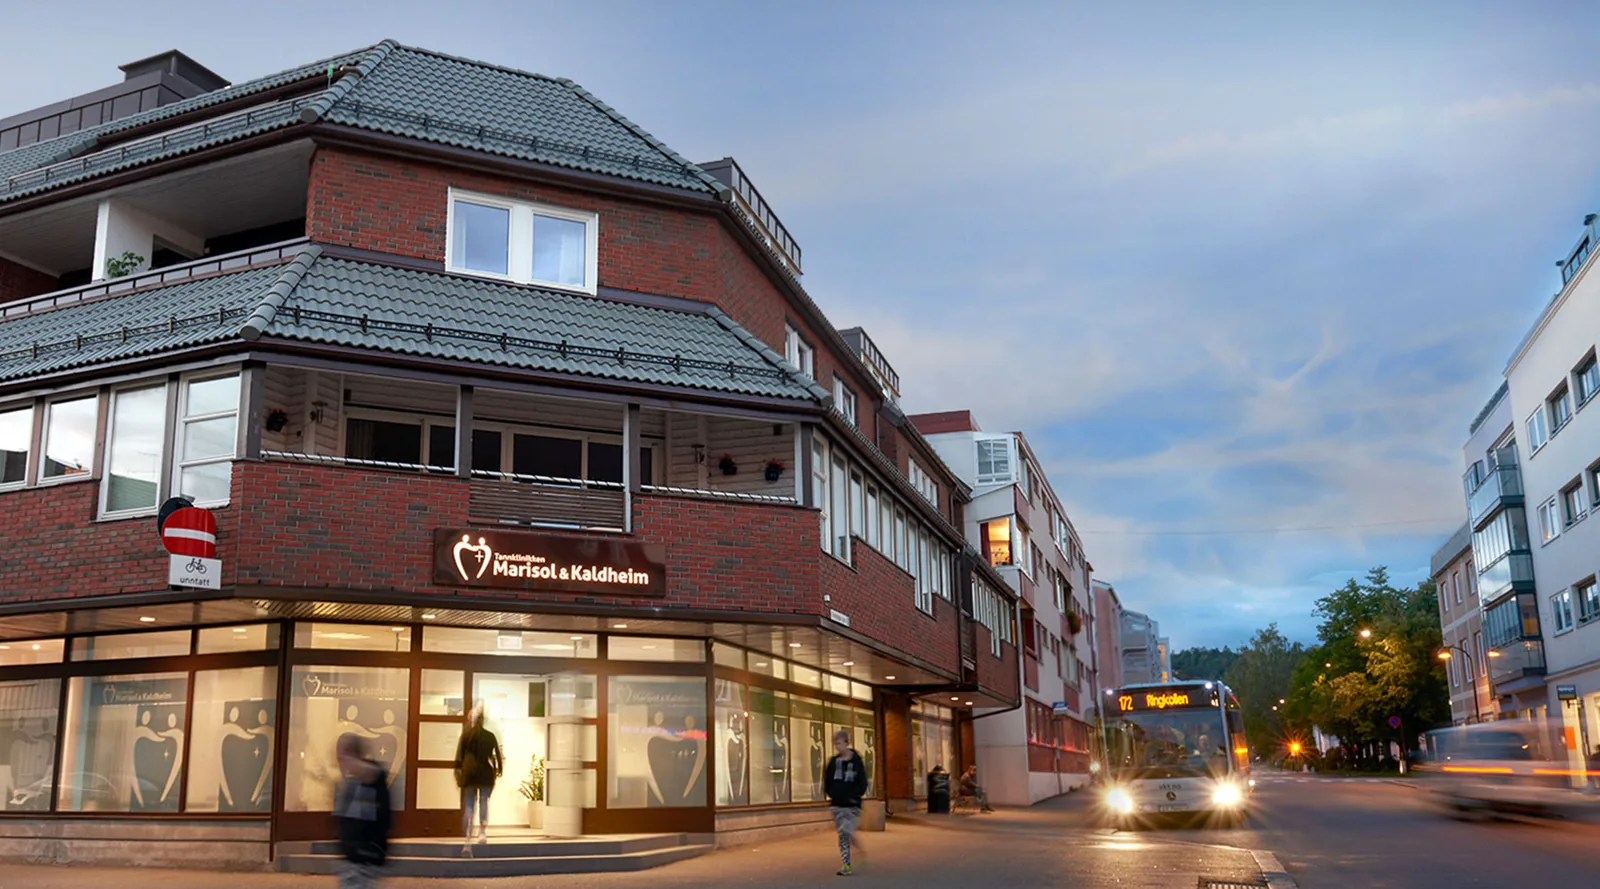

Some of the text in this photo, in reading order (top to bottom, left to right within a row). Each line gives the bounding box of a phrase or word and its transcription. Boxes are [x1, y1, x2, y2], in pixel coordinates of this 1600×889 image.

[494, 552, 546, 563] Tannklinikken
[493, 560, 649, 585] Marisol & Kaldheim
[179, 577, 210, 586] unntatt
[321, 686, 353, 695] Marisol
[1118, 693, 1189, 710] 172 Ringkollen
